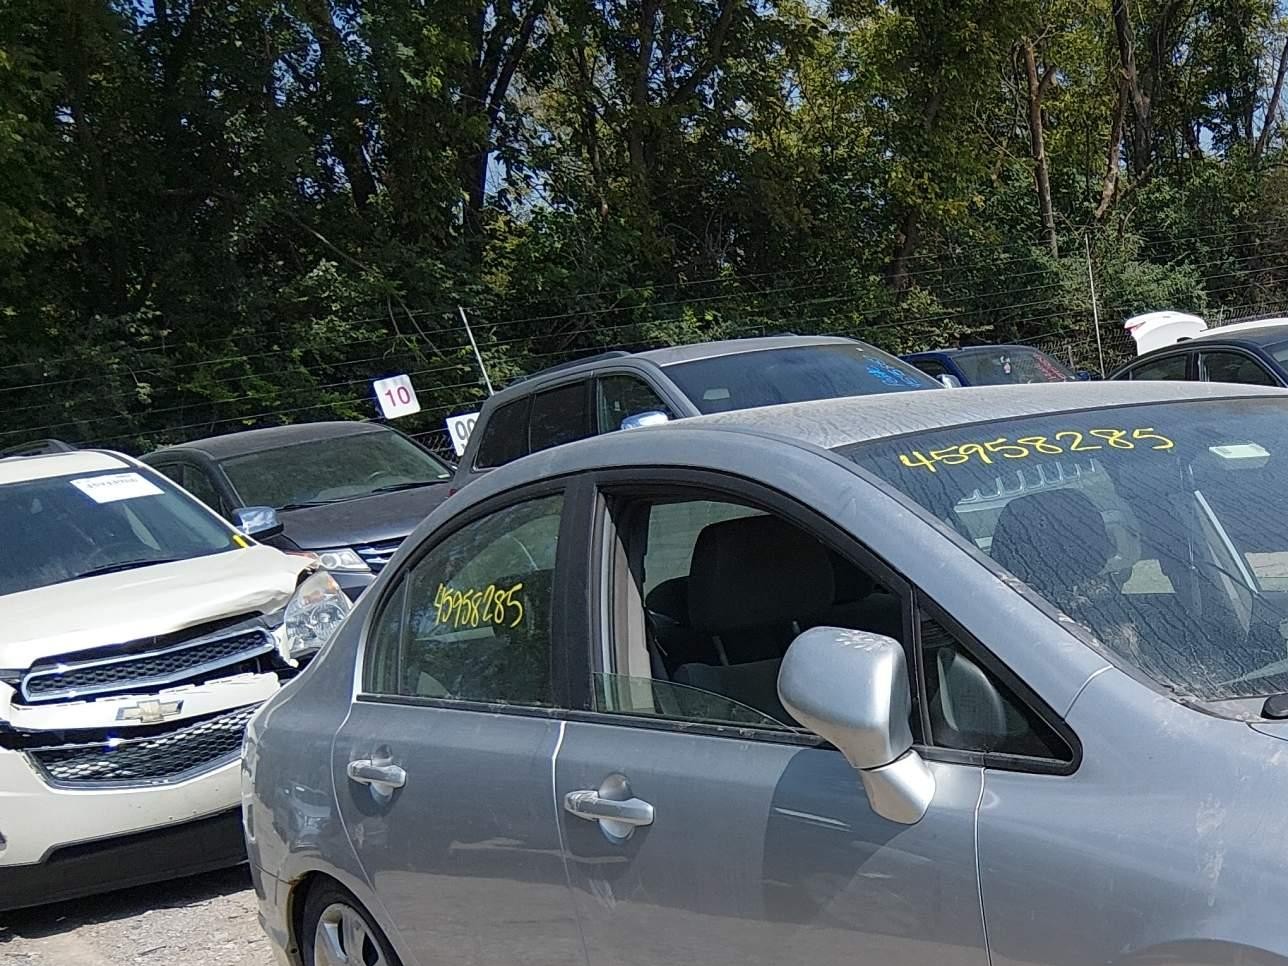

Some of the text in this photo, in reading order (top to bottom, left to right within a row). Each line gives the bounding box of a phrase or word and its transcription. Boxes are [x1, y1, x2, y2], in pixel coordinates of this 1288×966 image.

[384, 386, 411, 407] 10
[899, 427, 1174, 473] 45958285
[433, 582, 524, 629] 45958285
